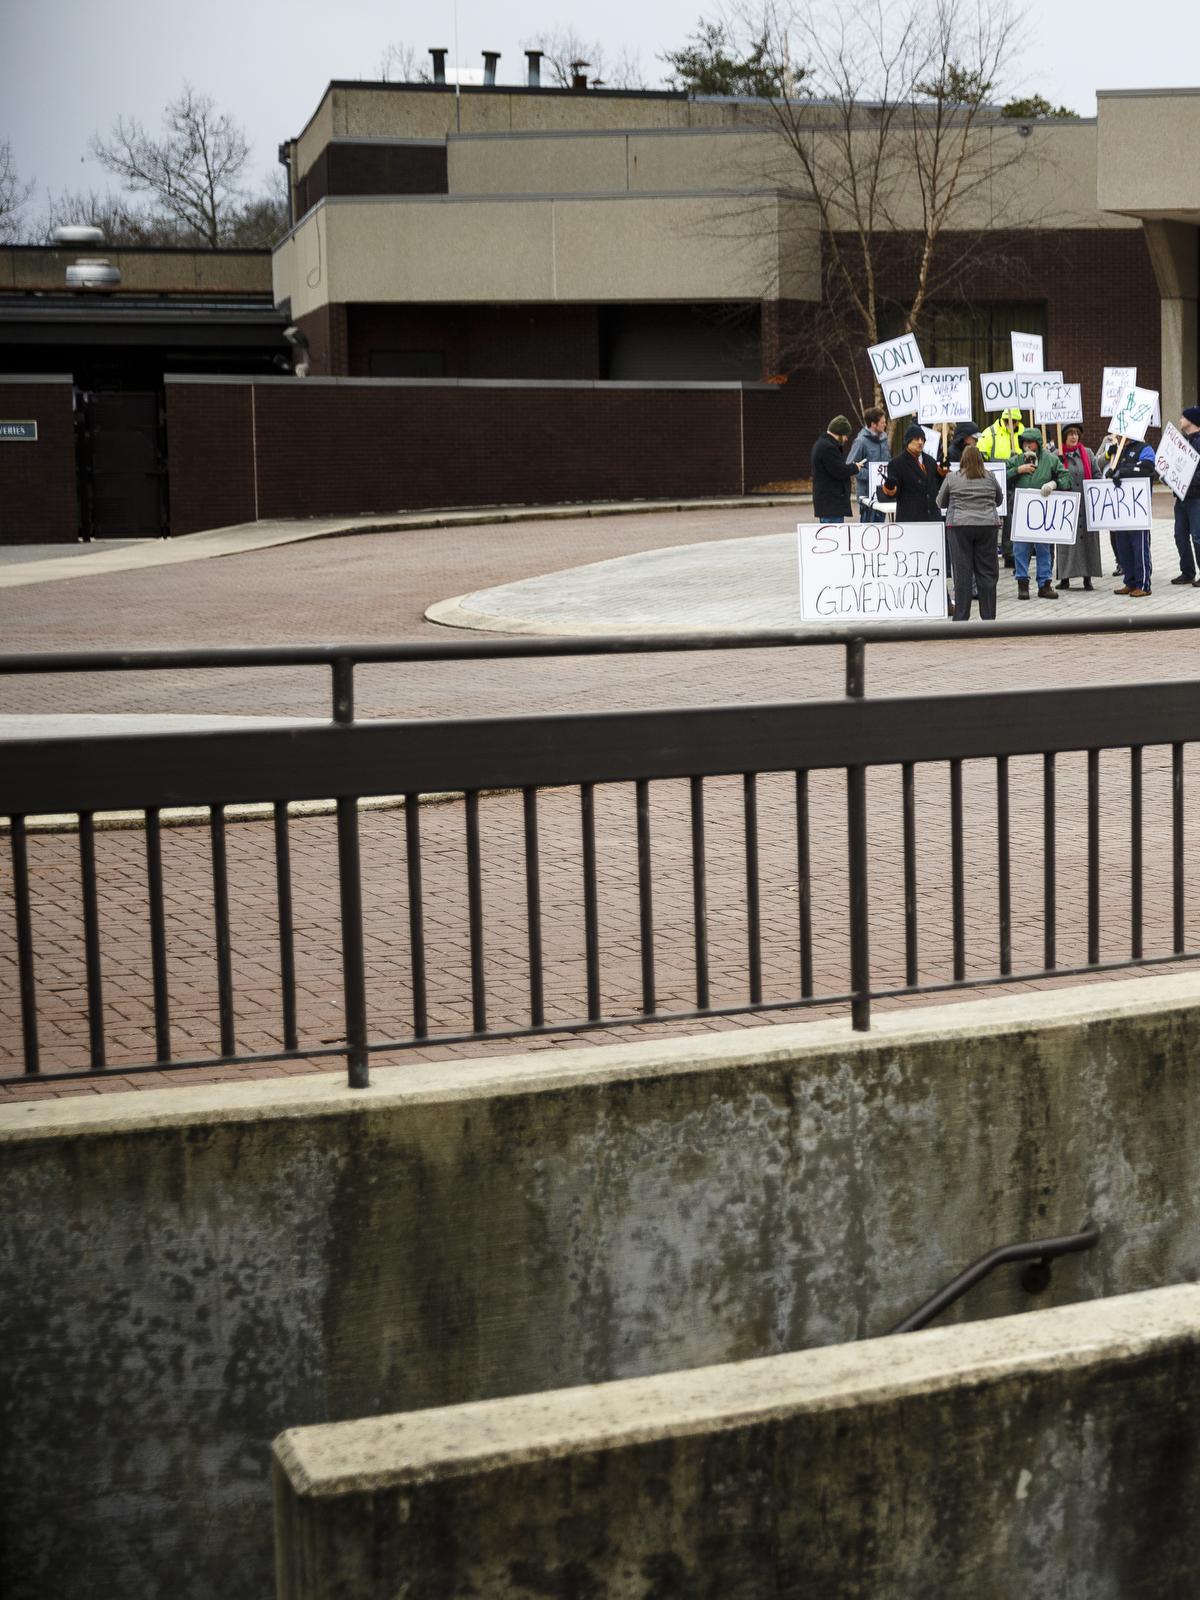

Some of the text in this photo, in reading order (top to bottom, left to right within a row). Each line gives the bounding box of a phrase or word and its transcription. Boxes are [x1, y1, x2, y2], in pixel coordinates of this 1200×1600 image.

[939, 394, 953, 402] IS
[986, 379, 1018, 400] OU
[1047, 387, 1071, 400] FIX
[921, 405, 937, 417] ED
[1039, 411, 1081, 420] PRIVATIZE
[1052, 401, 1066, 409] NOT
[1156, 456, 1187, 495] FOR SALE
[1026, 499, 1075, 532] OUR
[1087, 486, 1147, 522] PARK
[812, 523, 904, 554] STOP
[841, 551, 939, 578] THE BIG
[815, 579, 933, 615] GIVEAWAY
